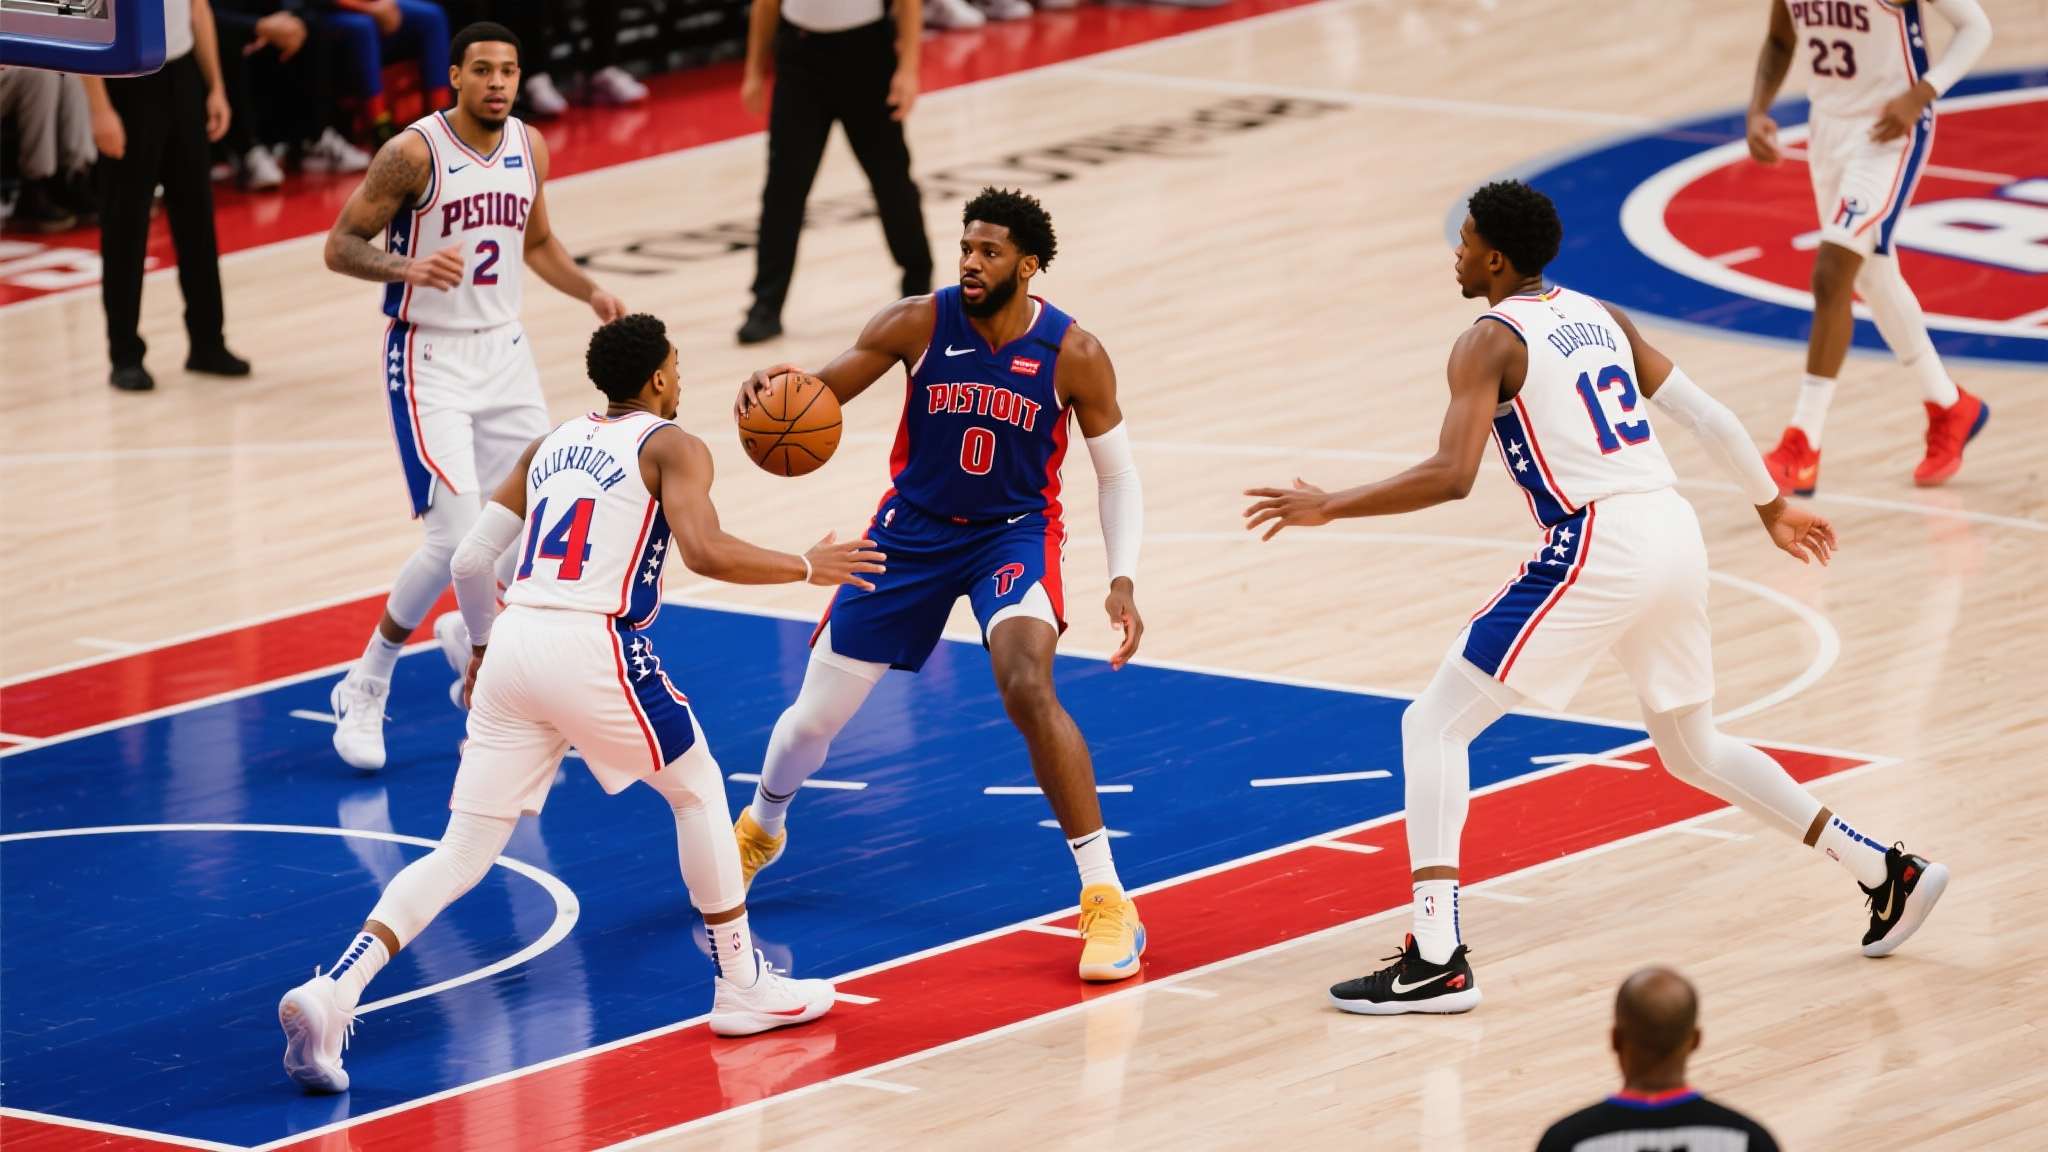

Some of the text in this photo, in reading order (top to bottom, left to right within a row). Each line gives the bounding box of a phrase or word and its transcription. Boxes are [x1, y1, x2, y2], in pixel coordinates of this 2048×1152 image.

[1808, 37, 1856, 79] 23
[473, 239, 500, 286] 2
[1575, 364, 1651, 456] 13
[960, 426, 996, 476] 0
[516, 496, 597, 581] 14
